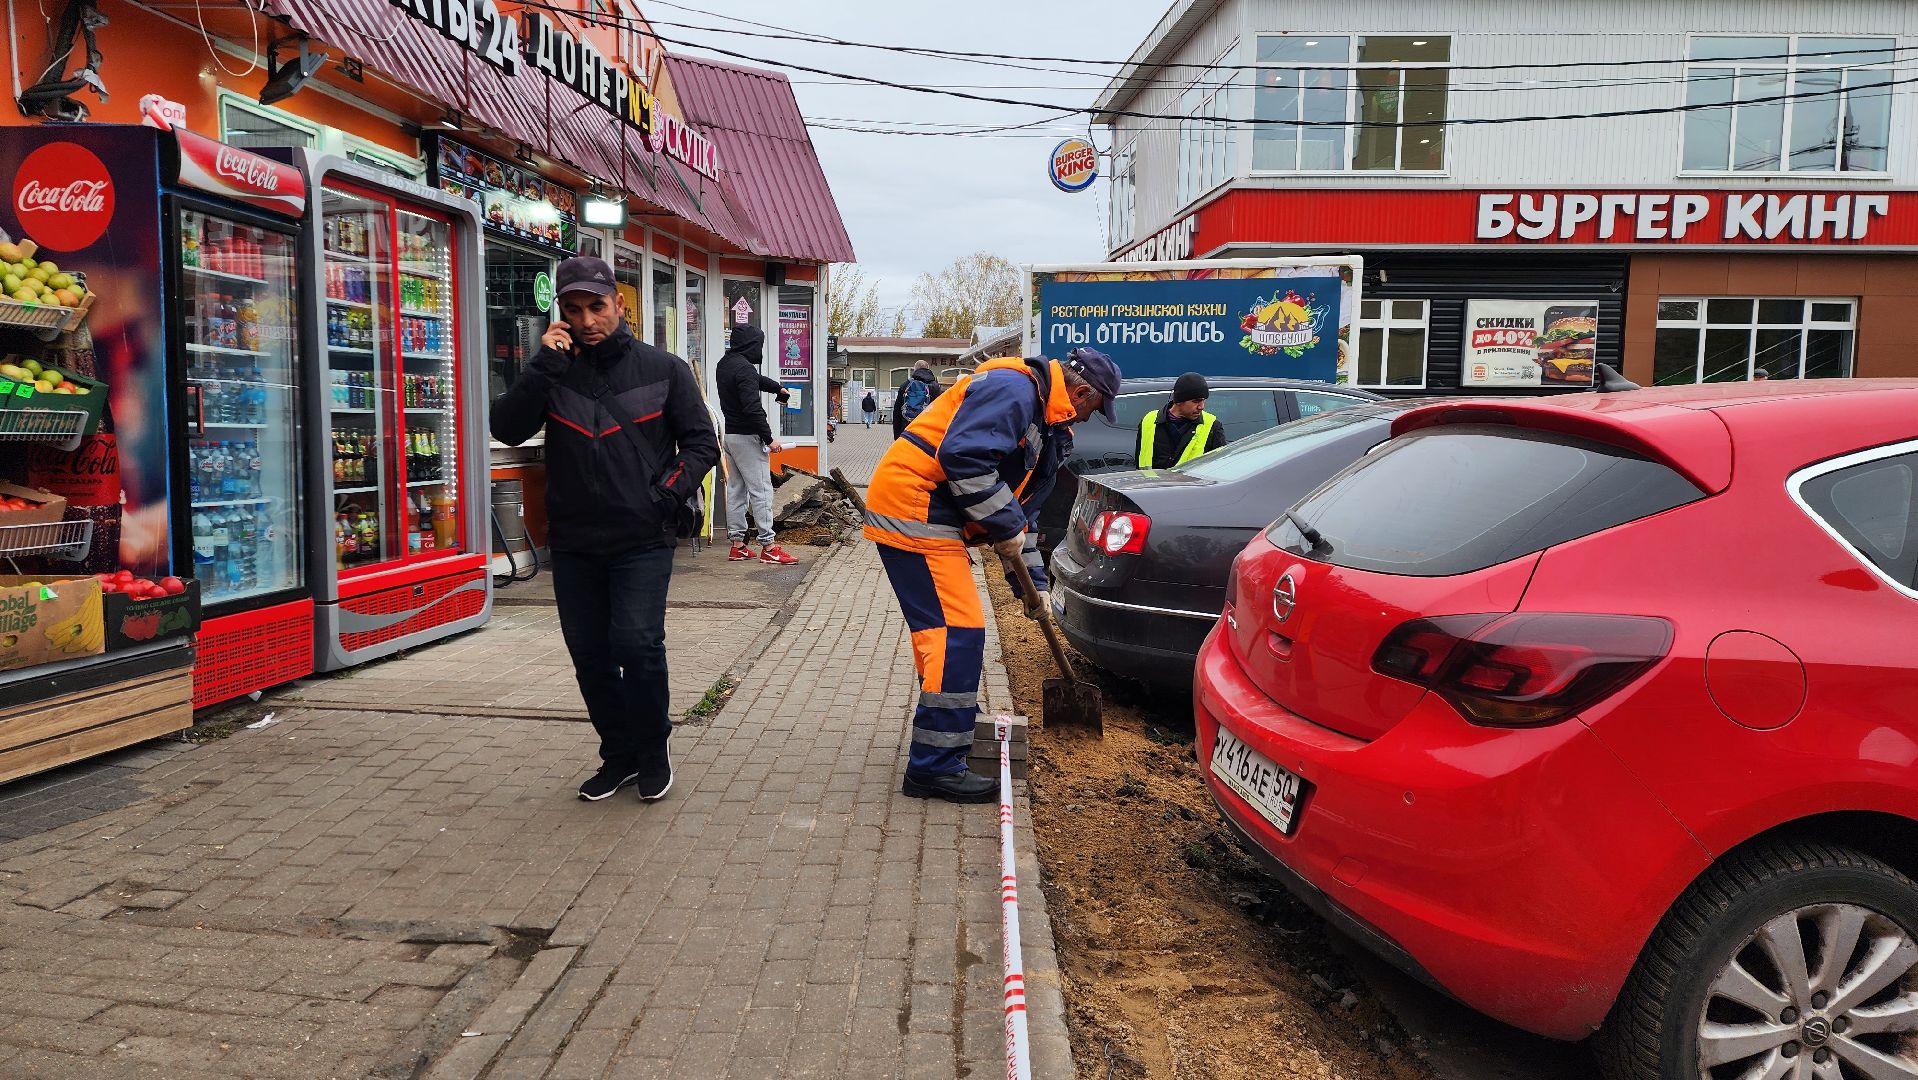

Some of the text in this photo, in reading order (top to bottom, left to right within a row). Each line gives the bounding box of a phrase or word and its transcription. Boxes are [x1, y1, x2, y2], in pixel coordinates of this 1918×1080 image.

[400, 0, 521, 78] ТЫ 24
[536, 13, 629, 121] ДОНЕР
[665, 114, 720, 182] СКУПКА
[1055, 147, 1093, 168] BURGER
[215, 146, 279, 192] Coca-Cola
[1057, 156, 1095, 181] KING
[18, 180, 109, 212] Coca-Cola
[1477, 193, 1890, 240] БУРГЕР КИНГ
[1156, 213, 1196, 261] КИНГ
[1051, 303, 1227, 317] РЕСТОРАН ГРУЗИНСКОЙ КУХНИ
[1476, 317, 1535, 329] СКИДКИ
[1050, 320, 1225, 344] МЫ ОТКРЫЛИСЬ
[1259, 332, 1308, 345] ИМЕРУЛИ
